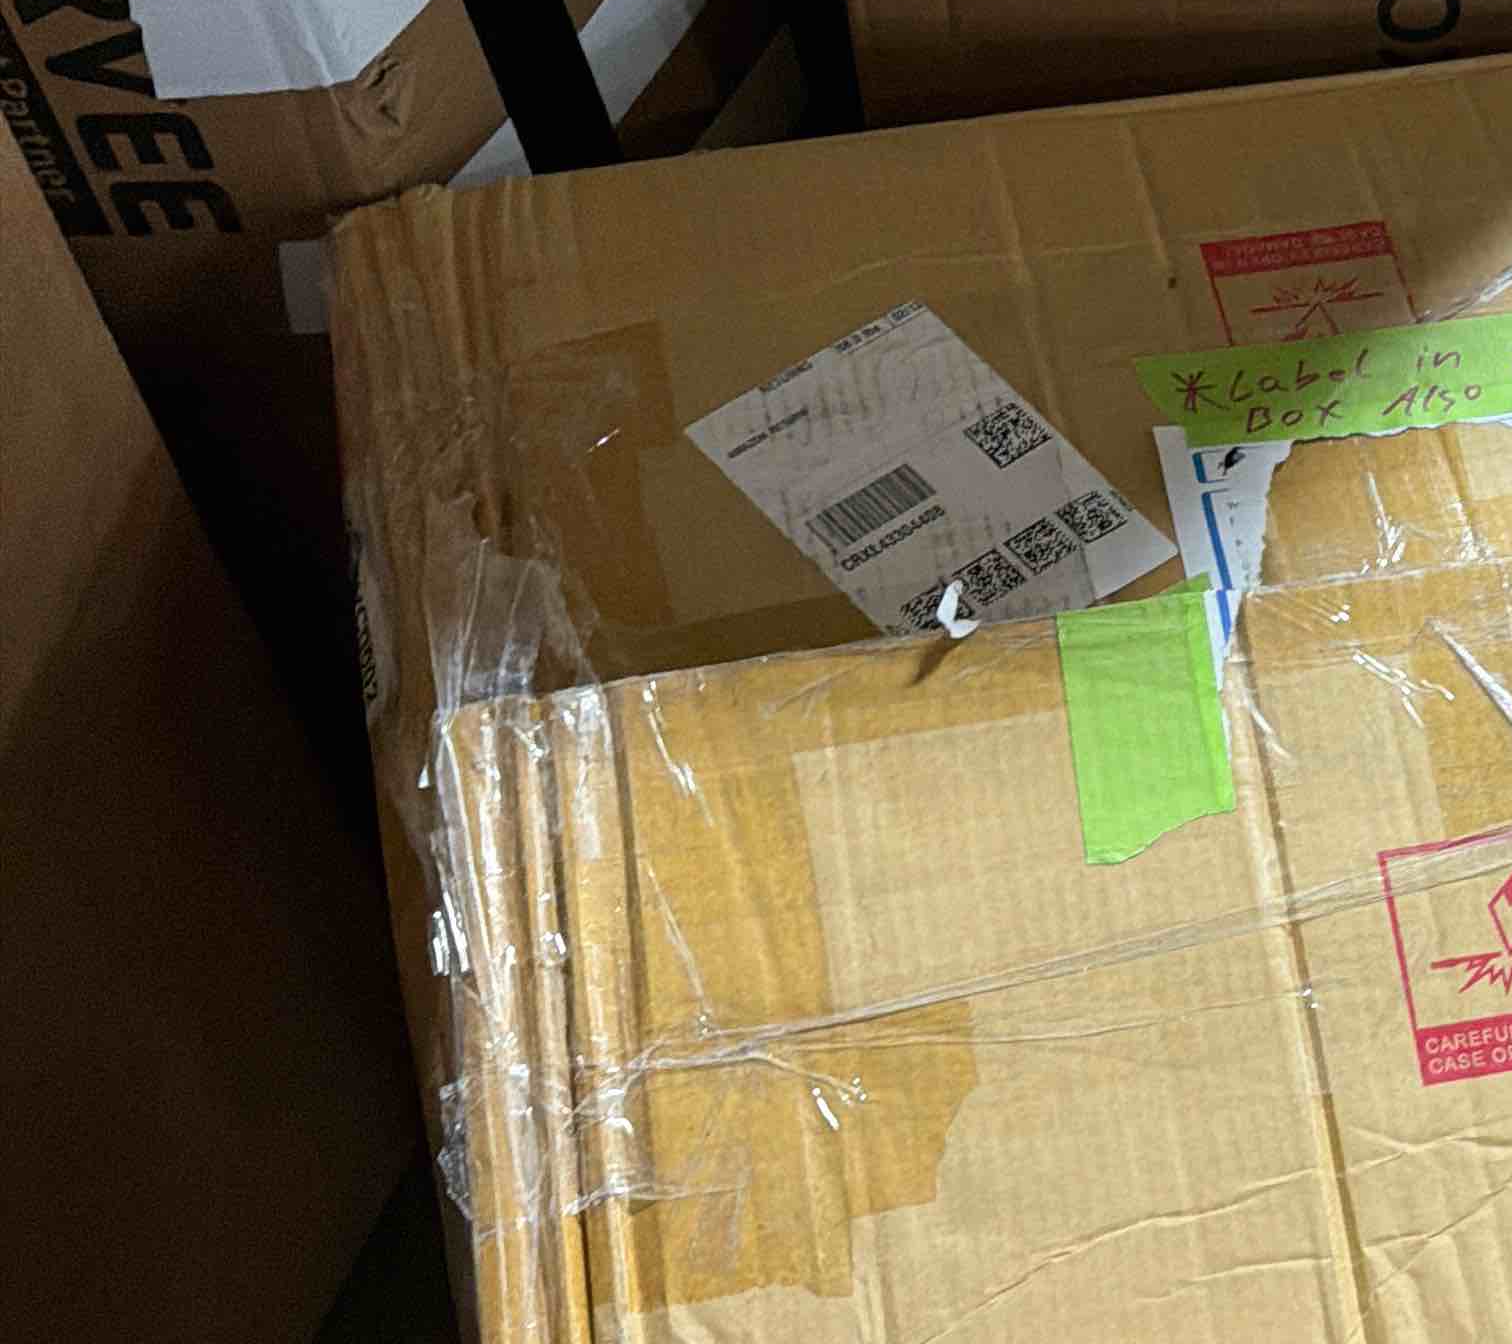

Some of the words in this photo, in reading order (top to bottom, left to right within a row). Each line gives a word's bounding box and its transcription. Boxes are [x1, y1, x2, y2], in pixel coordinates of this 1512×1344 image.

[1229, 348, 1370, 404] Label
[1416, 346, 1461, 372] in
[1428, 1053, 1485, 1075] CASE
